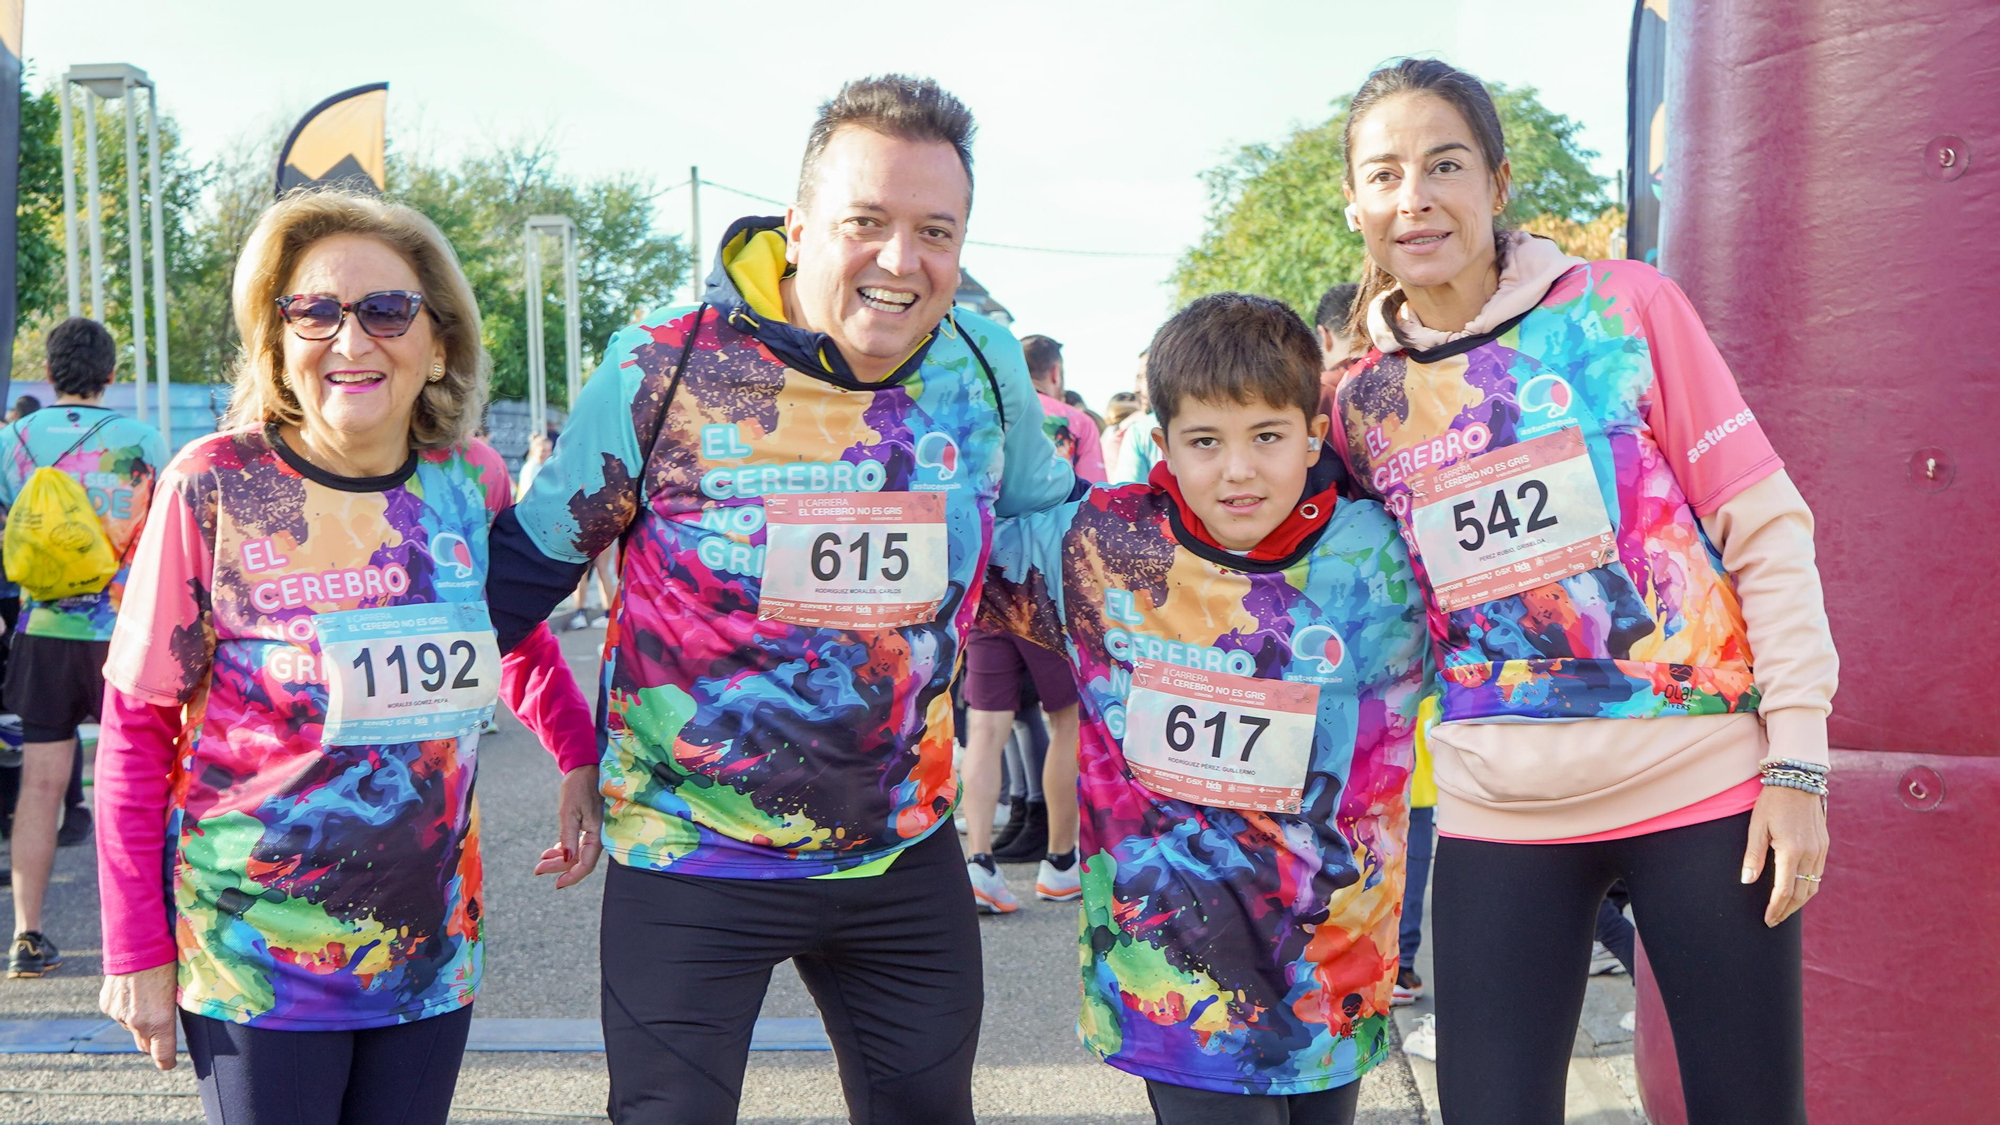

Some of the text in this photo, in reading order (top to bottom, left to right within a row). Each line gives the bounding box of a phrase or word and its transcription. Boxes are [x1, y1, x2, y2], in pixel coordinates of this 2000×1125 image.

[705, 427, 750, 456] EL
[1366, 427, 1390, 457] EL
[1373, 426, 1487, 491] CEREBRO
[1438, 464, 1472, 482] CARRERA
[705, 463, 883, 496] CEREBRO
[1435, 455, 1530, 493] EL CEREBRO NO ES GRIS
[799, 507, 903, 516] EL CEREBRO NO ES GRIS
[805, 498, 849, 507] CARRERA
[1453, 479, 1559, 552] 542
[703, 508, 763, 533] NO
[242, 539, 287, 571] EL
[701, 539, 764, 575] GRI
[811, 532, 909, 581] 615
[254, 566, 408, 610] CEREBRO
[879, 587, 901, 595] CARLOS
[1105, 592, 1141, 622] EL
[261, 618, 314, 642] NO
[361, 620, 399, 631] CEREBRO
[401, 618, 415, 628] NO
[416, 617, 428, 626] ES
[429, 616, 448, 625] GRIS
[269, 652, 330, 682] GRI
[352, 639, 479, 698] 1192
[1106, 632, 1253, 676] CEREBRO
[1162, 676, 1266, 700] EL CEREBRO NO ES GRIS
[1169, 669, 1209, 683] CARRERA
[1166, 704, 1271, 762] 617
[1222, 767, 1256, 775] GUILLERMO
